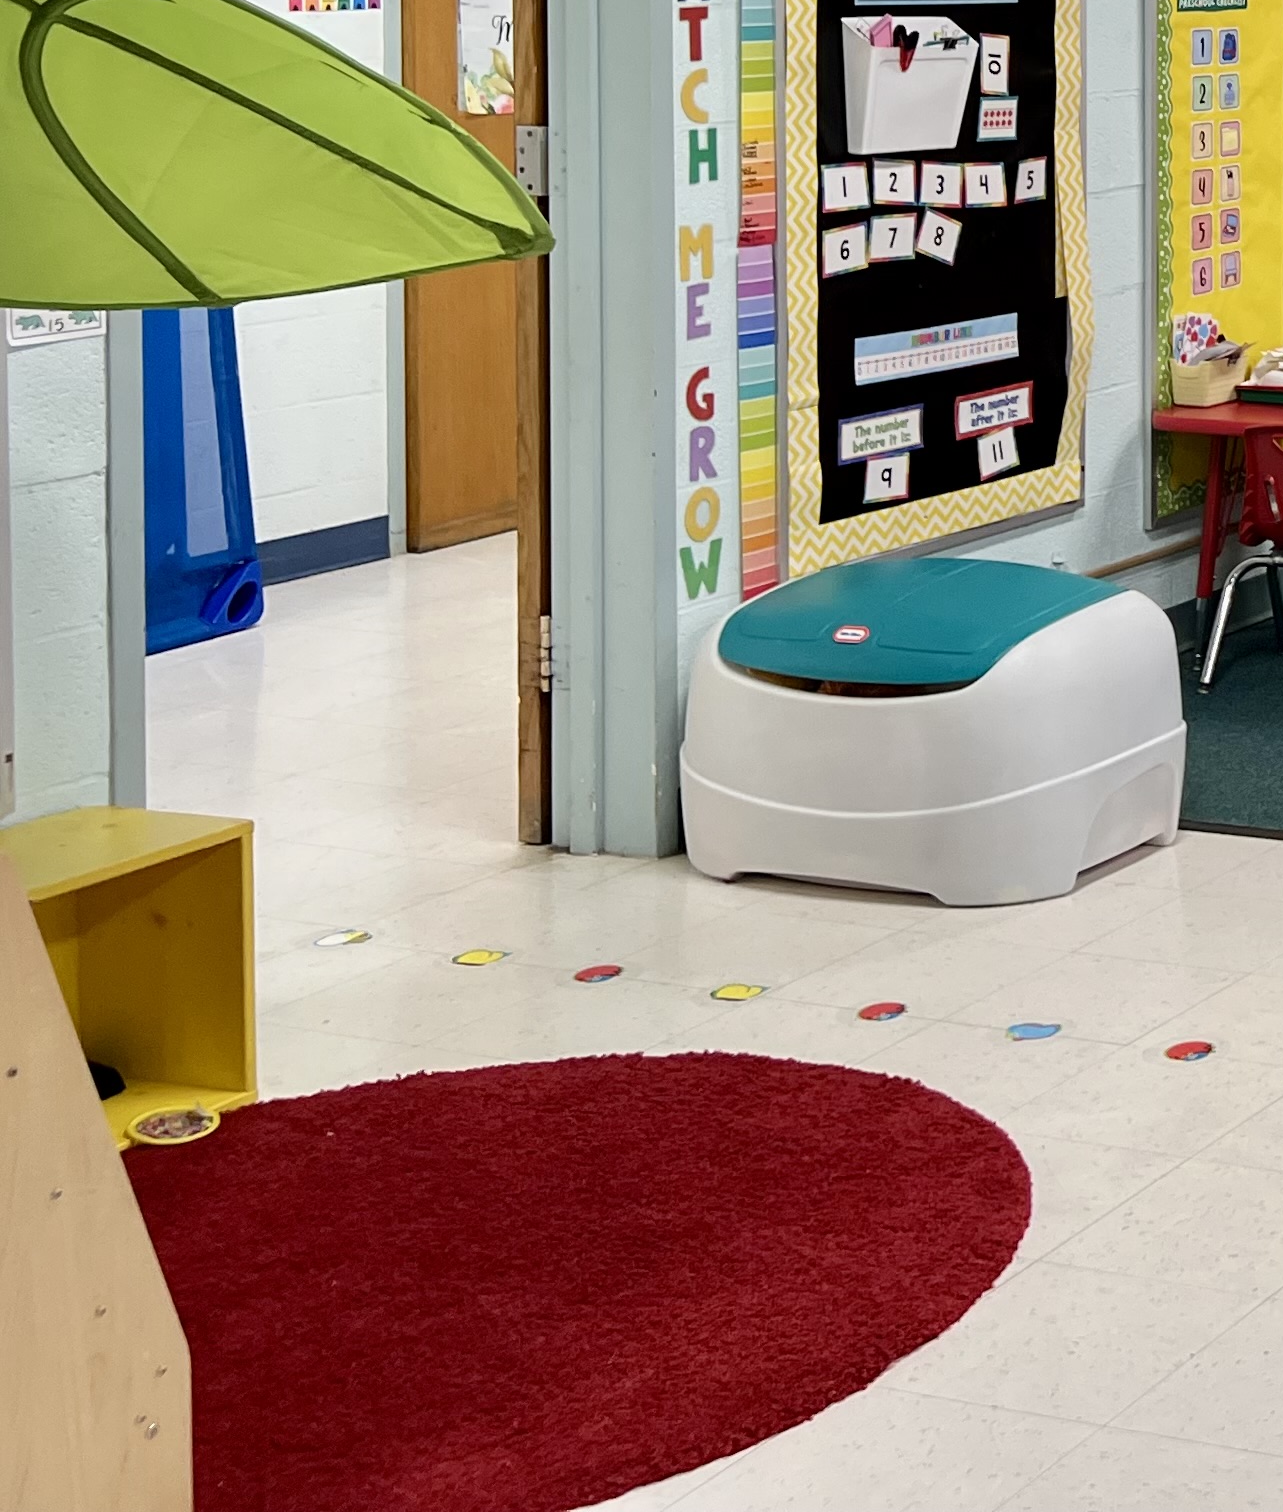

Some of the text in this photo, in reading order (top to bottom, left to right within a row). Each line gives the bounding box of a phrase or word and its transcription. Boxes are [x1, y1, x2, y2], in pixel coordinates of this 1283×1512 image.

[1200, 37, 1205, 58] 1
[1199, 83, 1206, 104] 2
[1199, 130, 1206, 152] 3
[842, 170, 1034, 198] 1 2 3 4 5
[1198, 176, 1206, 198] 4
[840, 226, 944, 260] 6 7 8
[1198, 222, 1206, 243] 5
[1199, 266, 1207, 287] 6
[49, 318, 65, 332] 15
[970, 394, 1019, 414] The number
[855, 417, 909, 438] The number
[971, 414, 993, 427] after
[853, 438, 885, 453] before
[889, 434, 897, 445] it
[992, 440, 1004, 465] 11
[680, 366, 724, 601] GROW
[881, 467, 892, 489] 9
